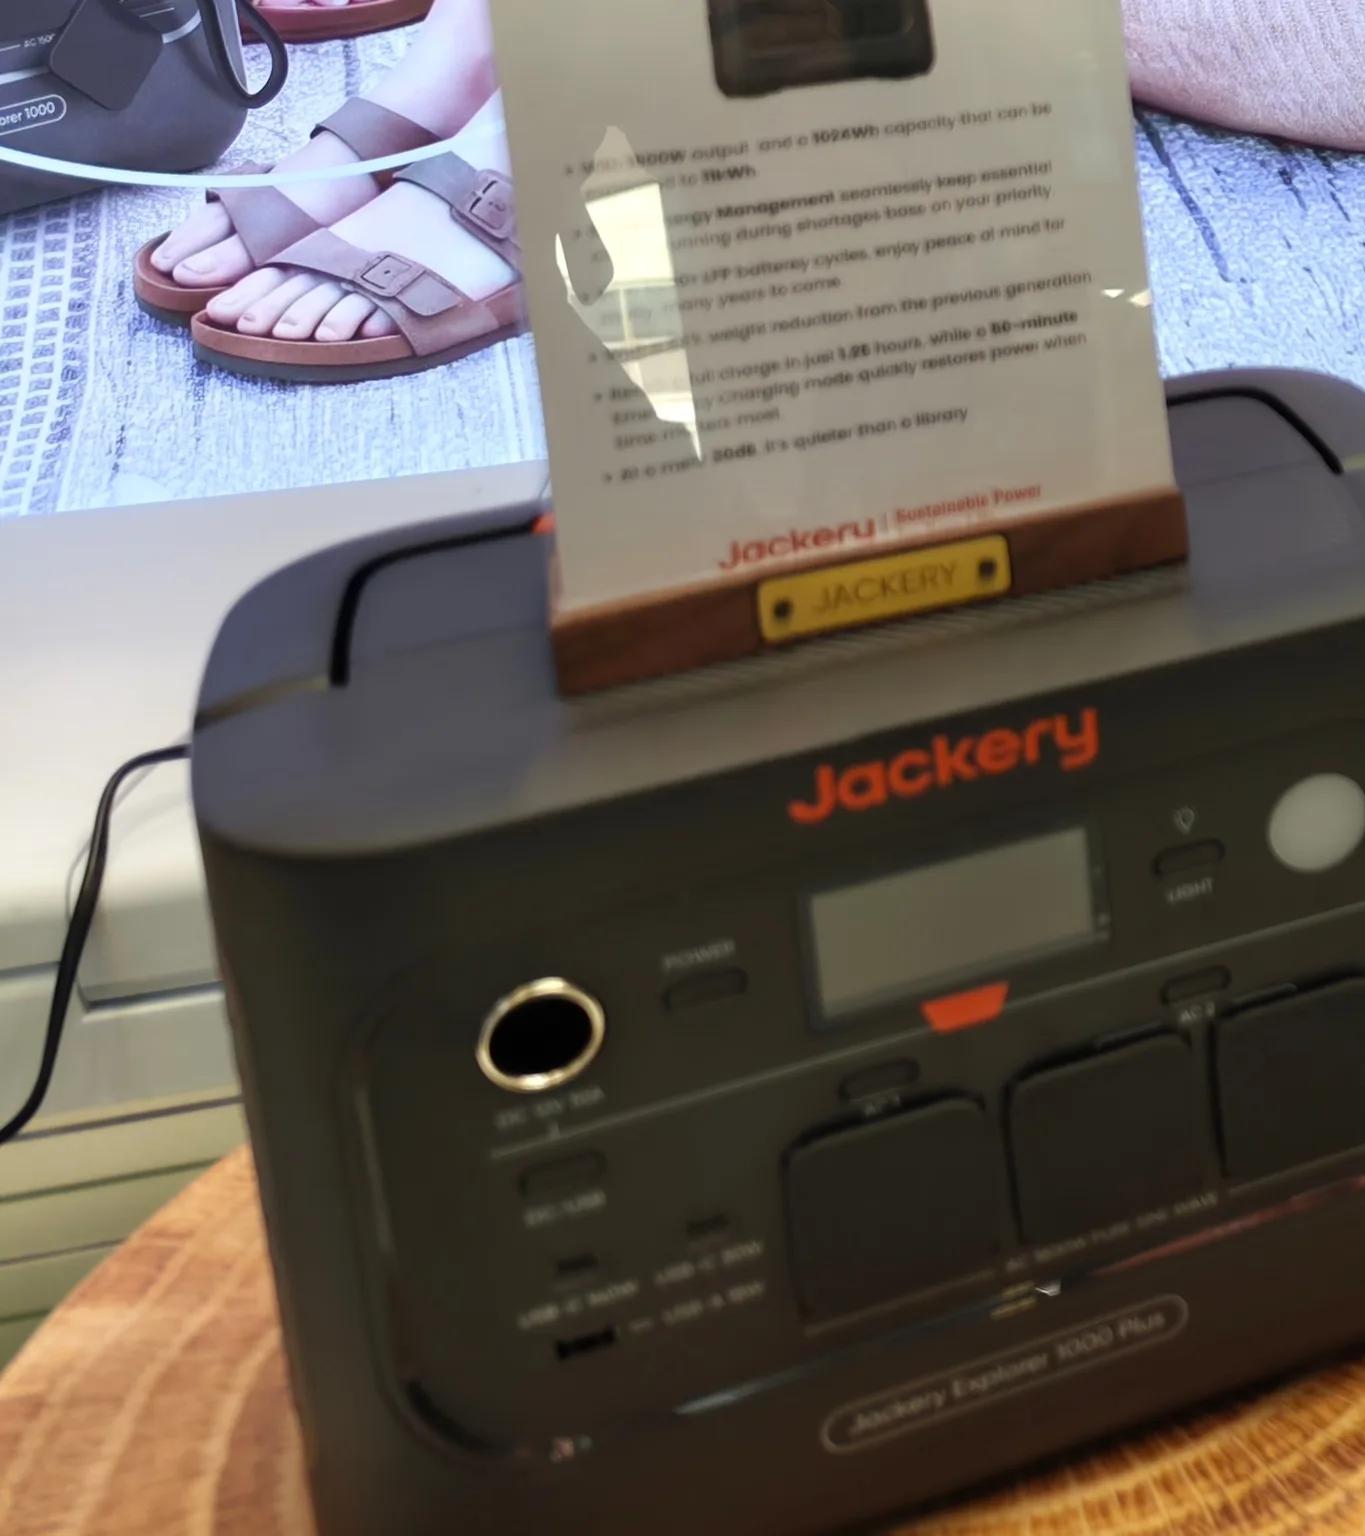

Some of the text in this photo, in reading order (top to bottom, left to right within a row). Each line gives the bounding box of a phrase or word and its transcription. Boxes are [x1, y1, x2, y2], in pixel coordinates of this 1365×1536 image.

[24, 102, 55, 118] 1000
[993, 485, 1041, 505] Power
[720, 518, 876, 570] Jackery
[811, 562, 959, 614] JACKERY
[788, 708, 1098, 823] Jackery
